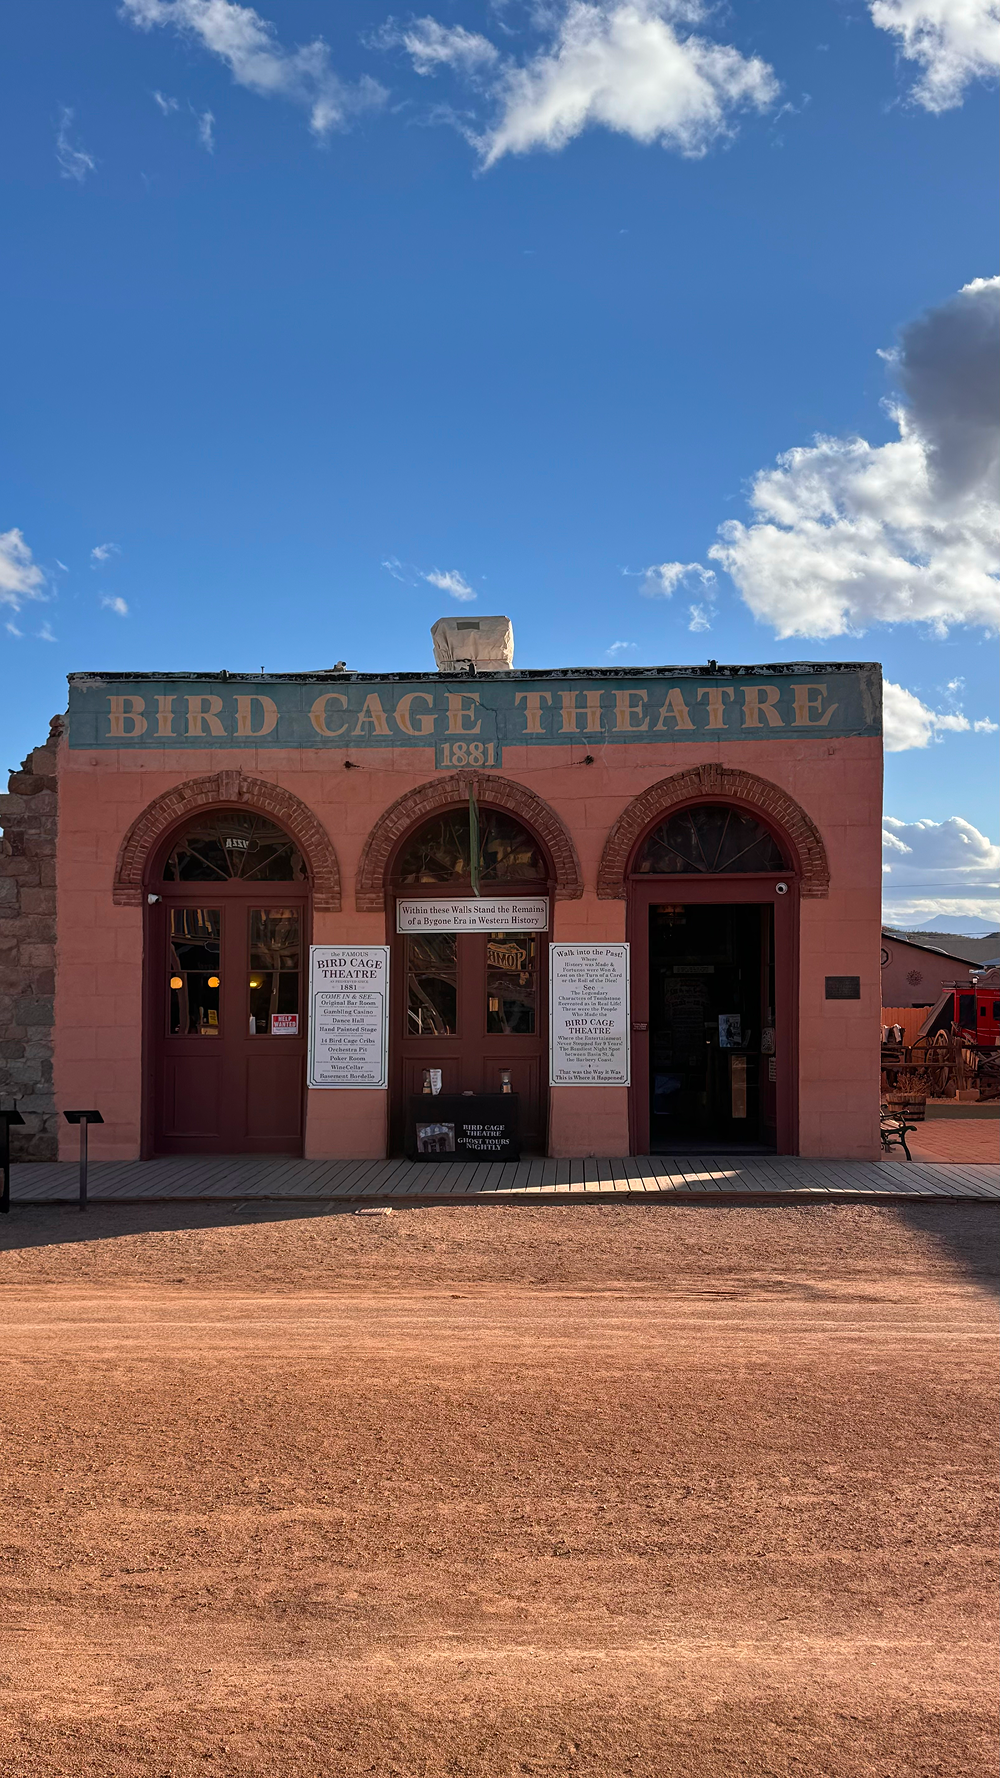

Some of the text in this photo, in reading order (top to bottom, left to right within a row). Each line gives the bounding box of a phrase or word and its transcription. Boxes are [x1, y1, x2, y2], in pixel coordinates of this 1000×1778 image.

[106, 684, 839, 737] BIRD CAGE THEATRE
[440, 742, 495, 766] 1881
[408, 917, 416, 925] of
[424, 917, 451, 926] Bygone
[511, 917, 539, 925] History
[606, 950, 623, 958] Past!
[317, 958, 382, 969] BIRD CAGE
[322, 970, 377, 978] THEATRE
[565, 1019, 615, 1027] BIRD CAGE
